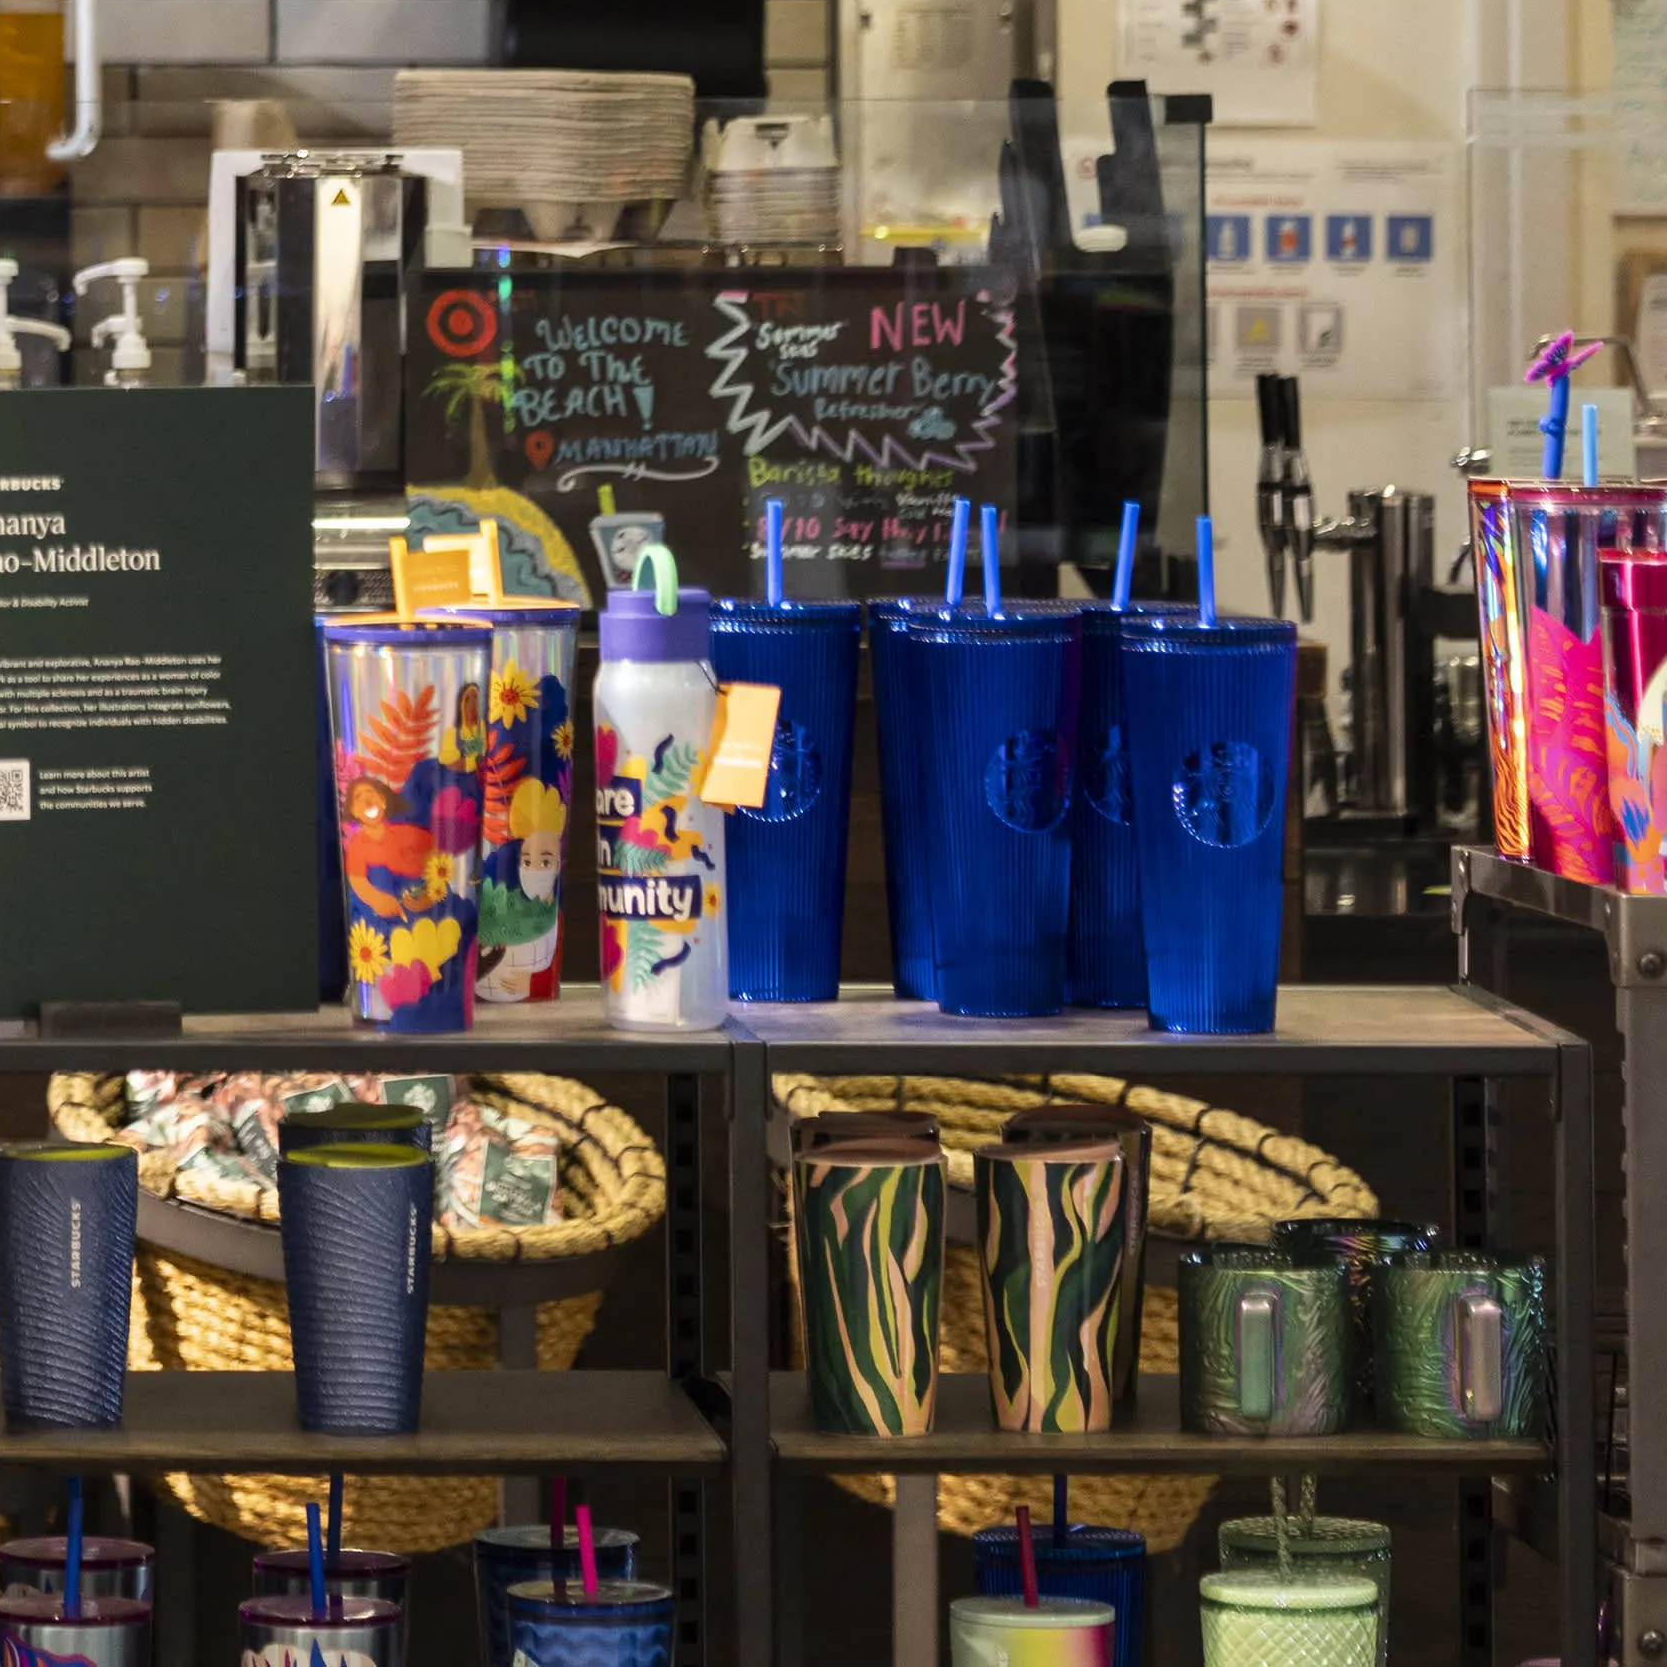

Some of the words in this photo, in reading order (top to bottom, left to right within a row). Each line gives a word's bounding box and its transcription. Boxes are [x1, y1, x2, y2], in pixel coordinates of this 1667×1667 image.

[870, 299, 965, 351] NEW
[39, 770, 61, 779] Learn
[63, 770, 85, 779] more
[87, 769, 109, 779] about
[112, 769, 126, 778] this
[128, 769, 149, 778] artist
[39, 785, 55, 795] and
[57, 785, 74, 794] how
[76, 785, 114, 794] Starbucks
[117, 784, 152, 794] supports
[70, 1199, 82, 1289] STARBUCKS
[407, 1201, 417, 1294] STARBUCKS
